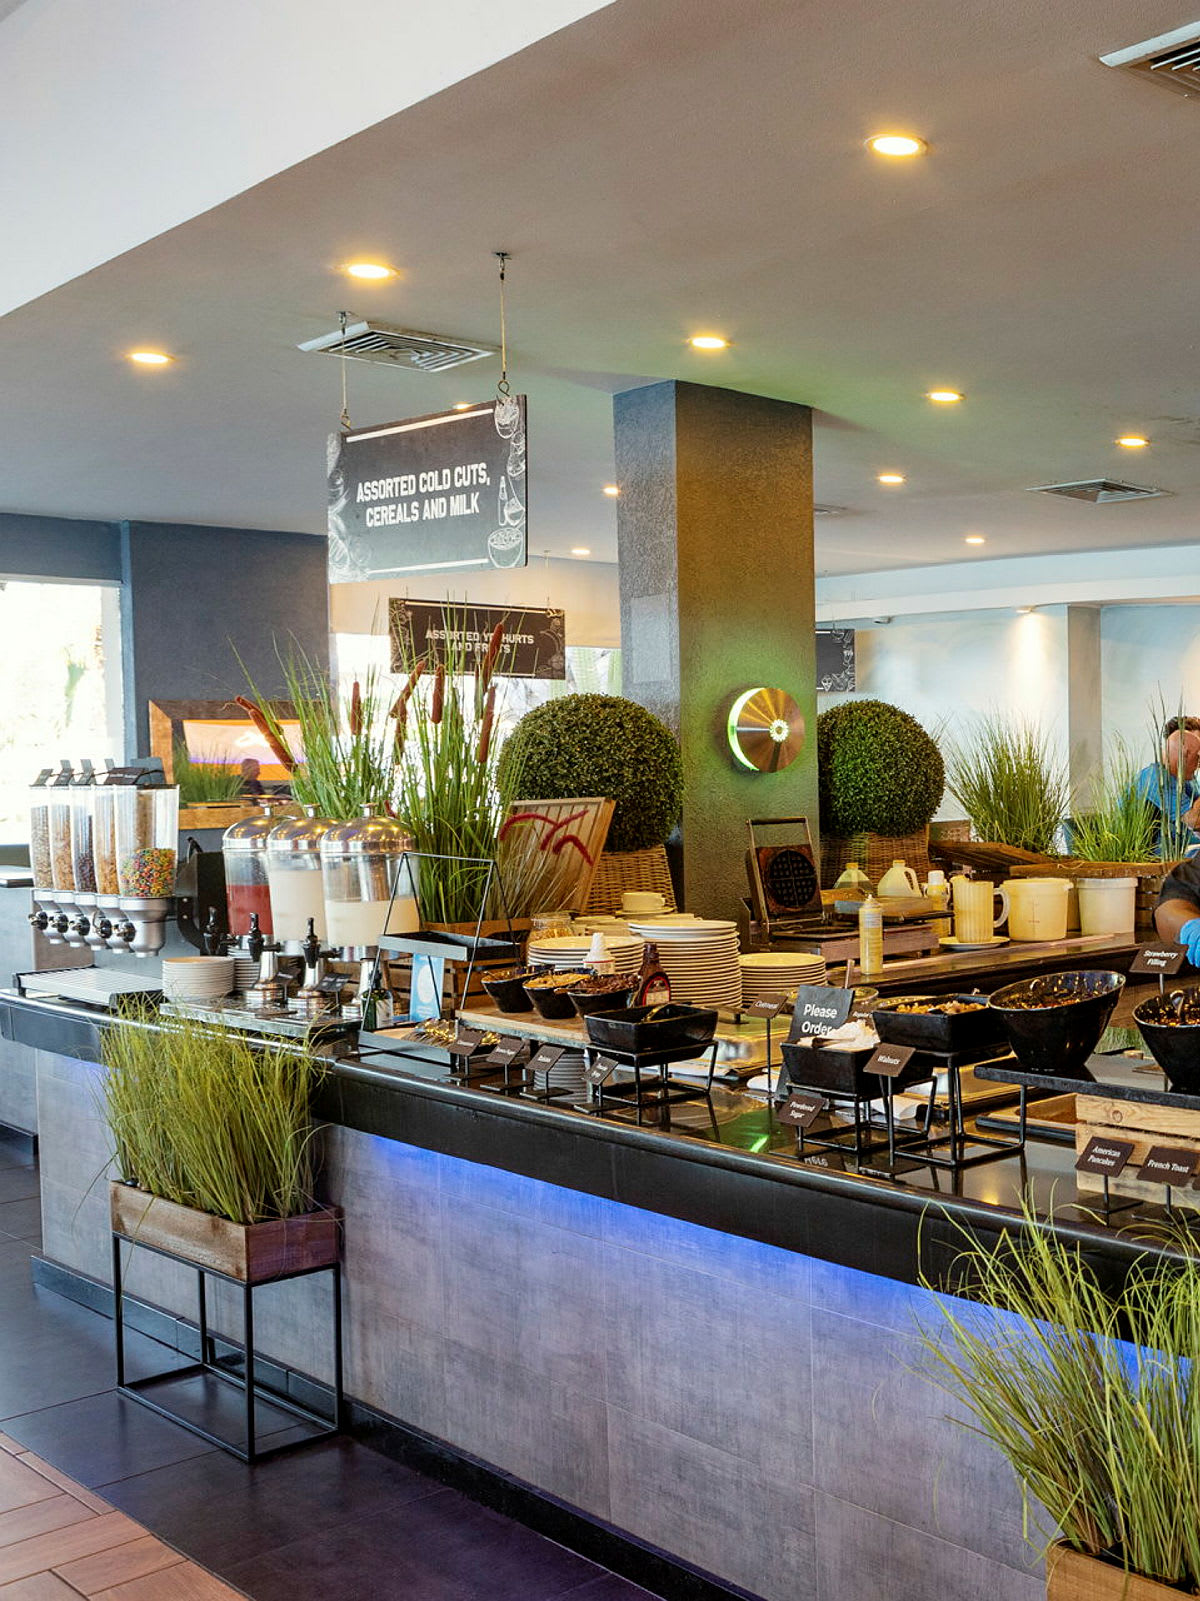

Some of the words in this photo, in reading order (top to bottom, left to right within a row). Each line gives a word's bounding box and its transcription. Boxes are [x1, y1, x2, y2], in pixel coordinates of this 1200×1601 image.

[356, 474, 417, 503] ASSORTED
[419, 468, 451, 493] COLD
[454, 462, 490, 488] CUTS,
[366, 501, 420, 528] CEREALS
[422, 497, 447, 520] AND
[449, 492, 480, 516] MILK
[483, 632, 535, 645] YOHURTS
[474, 642, 511, 654] FRTS
[1143, 949, 1178, 960] Strawberry
[1146, 958, 1167, 967] Filling
[803, 1003, 838, 1019] Please
[801, 1021, 833, 1036] Order
[1092, 1145, 1122, 1157] American
[1147, 1159, 1170, 1171] French
[1171, 1163, 1190, 1174] Toast
